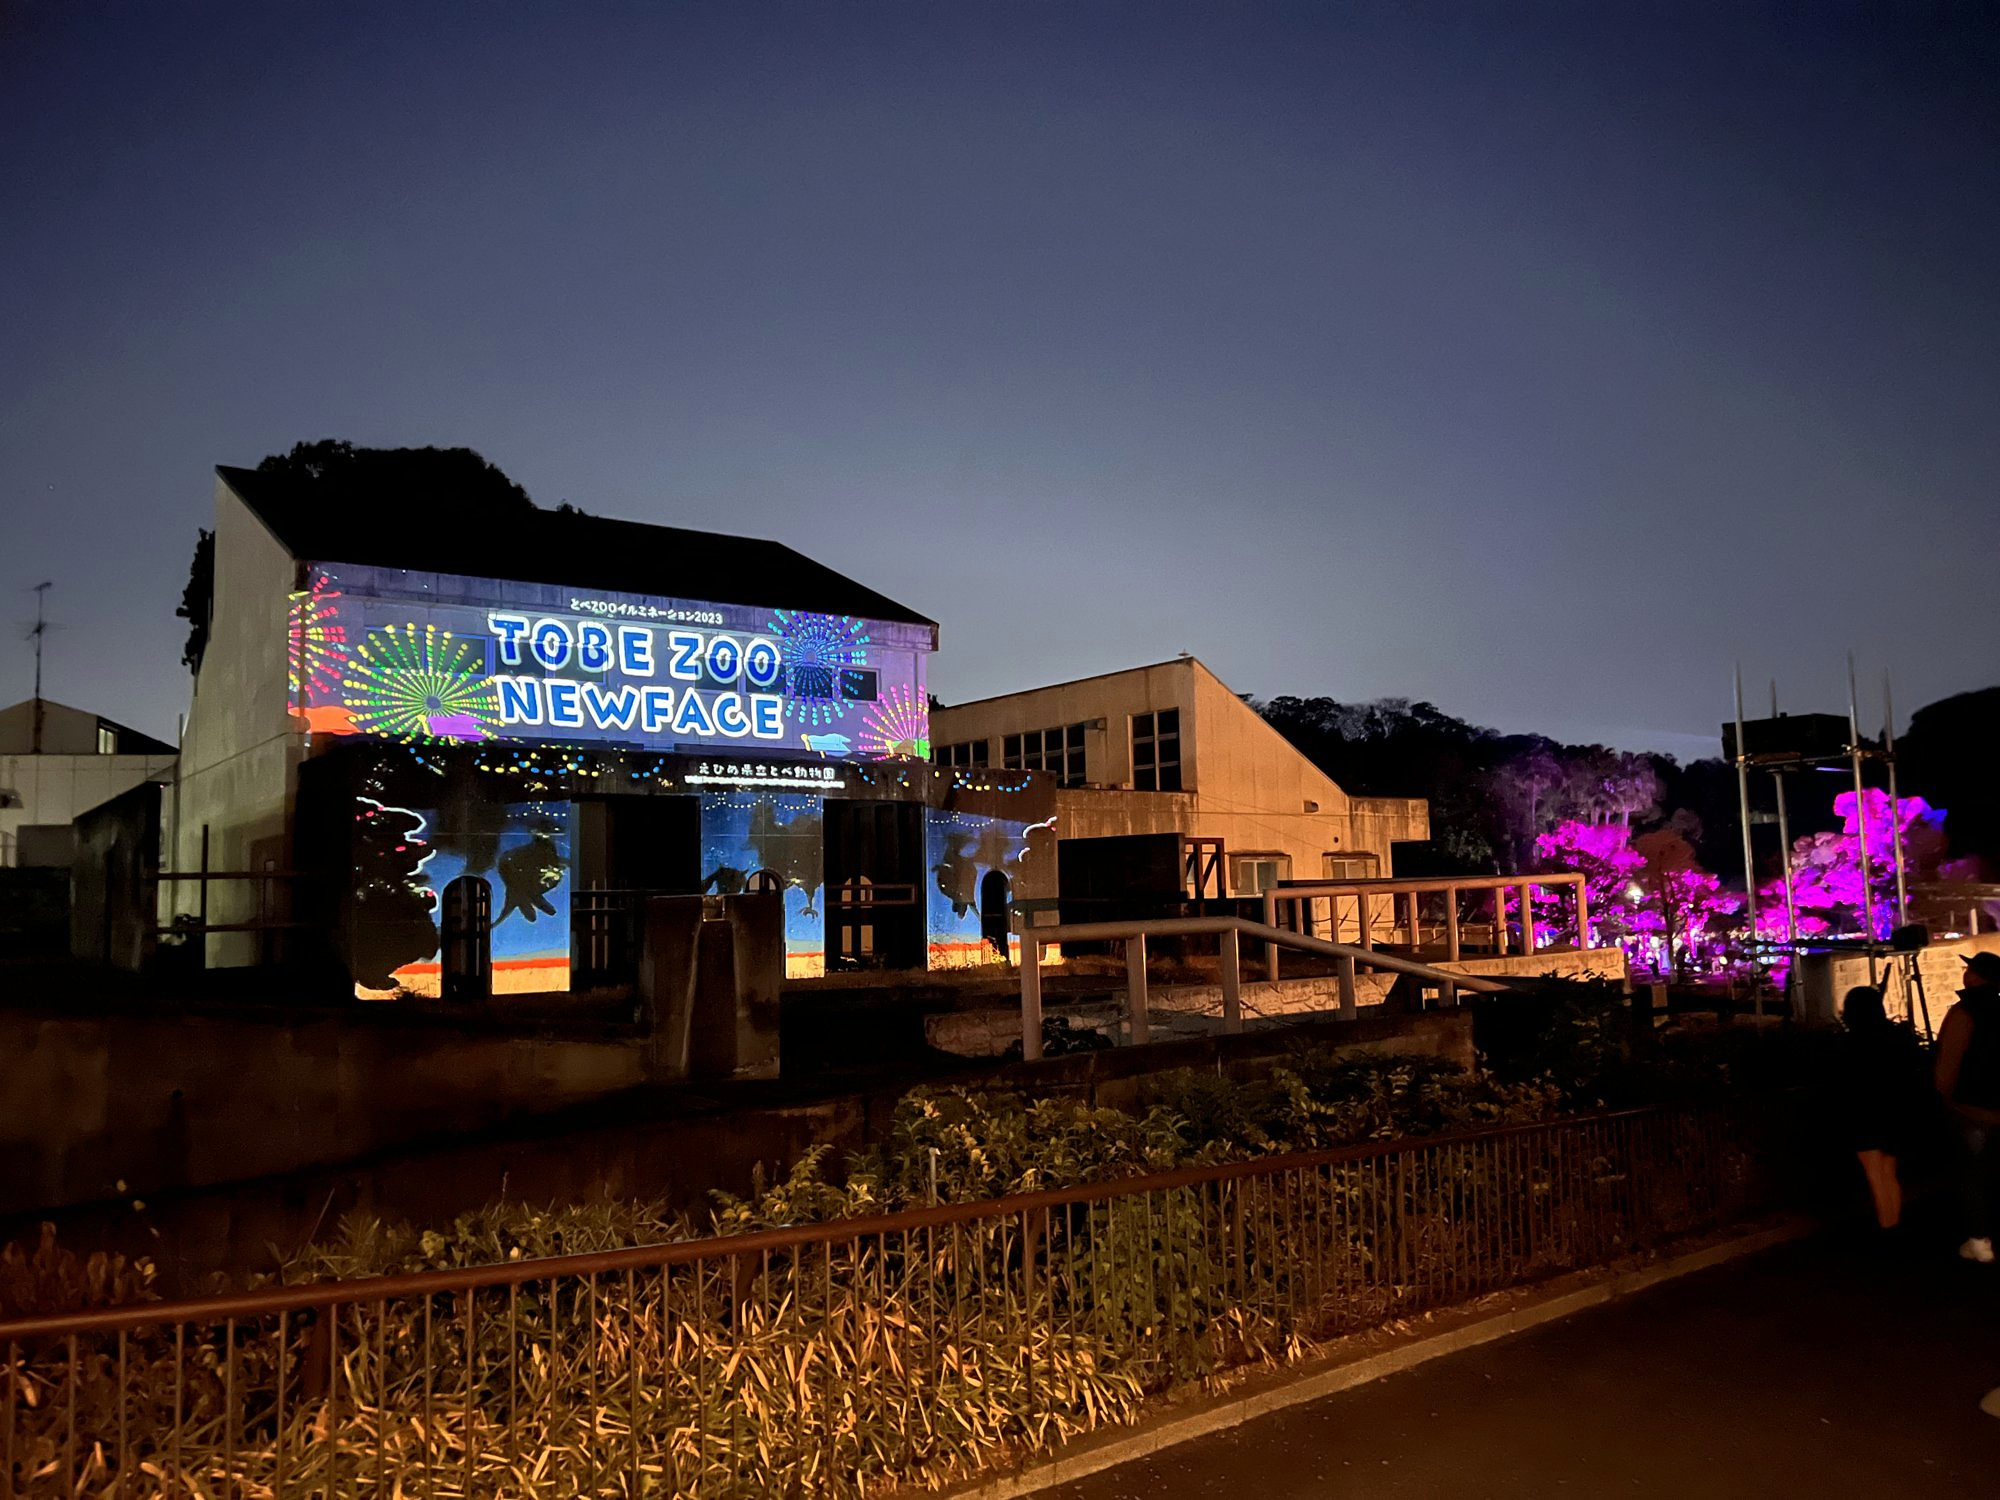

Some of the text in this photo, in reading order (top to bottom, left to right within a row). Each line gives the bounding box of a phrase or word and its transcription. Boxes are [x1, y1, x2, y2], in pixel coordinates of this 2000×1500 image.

[570, 598, 723, 624] とべZOOイルミネーション2023
[488, 613, 781, 686] TOBE ZOO
[496, 676, 784, 739] NEWFACE
[699, 762, 835, 780] えひめ県立とべ動物園
